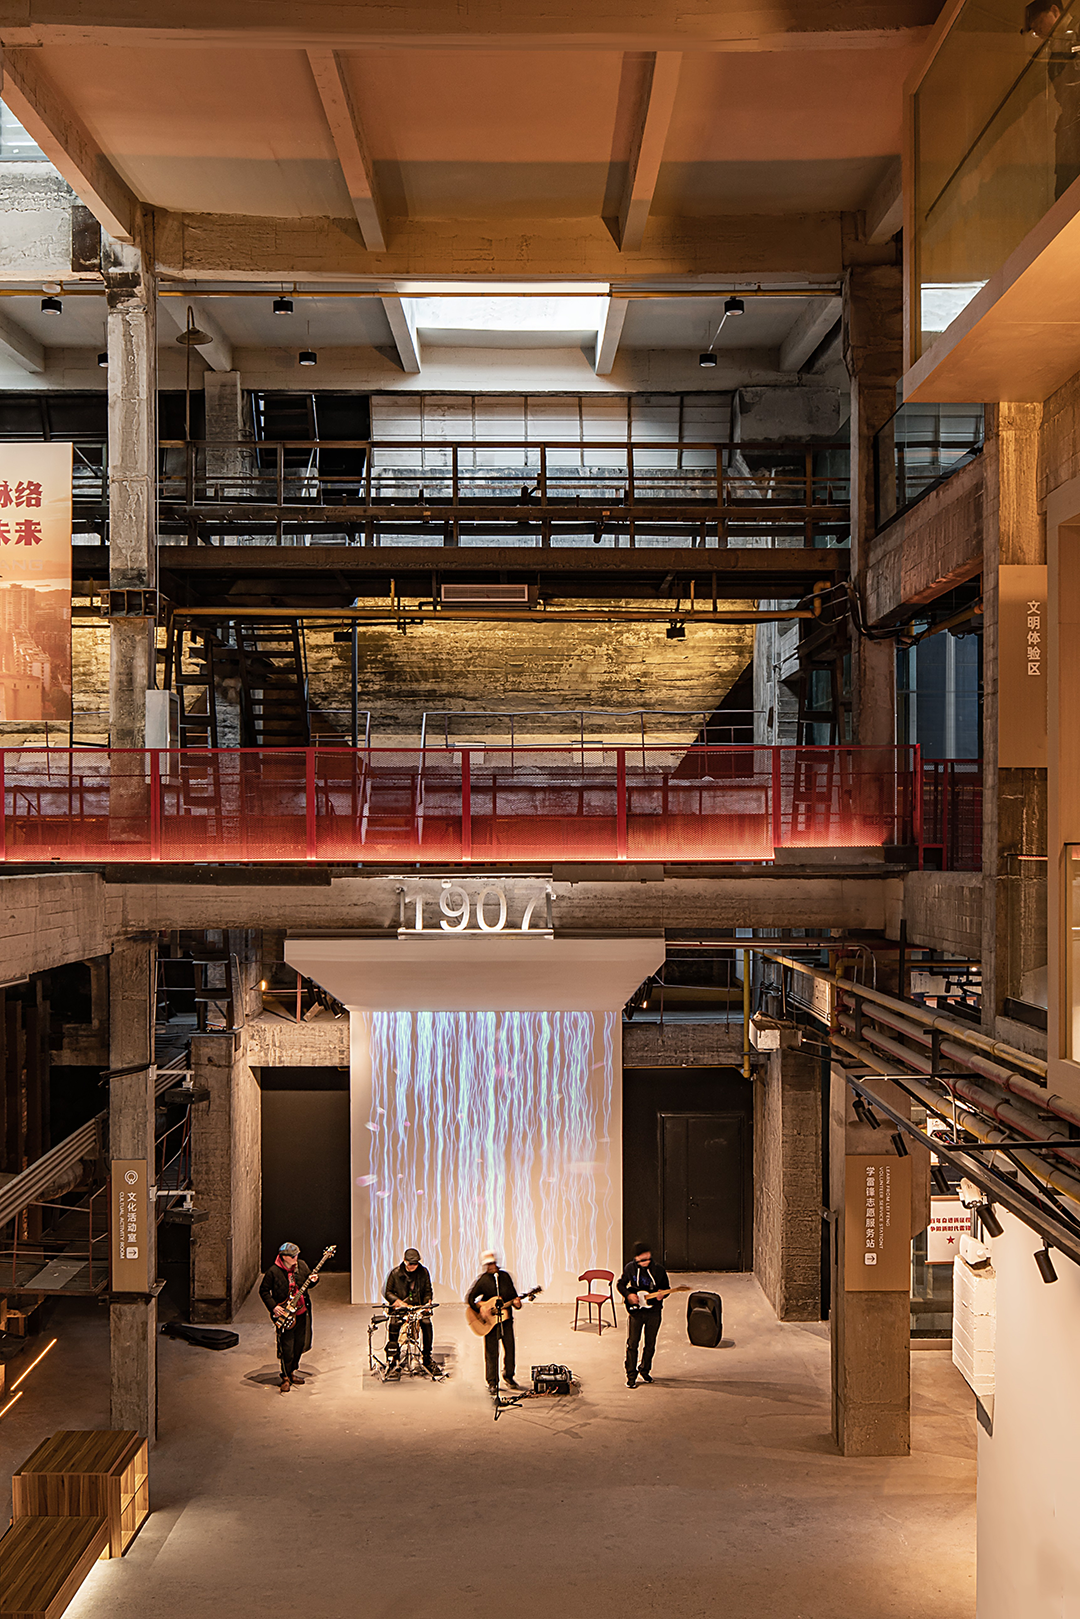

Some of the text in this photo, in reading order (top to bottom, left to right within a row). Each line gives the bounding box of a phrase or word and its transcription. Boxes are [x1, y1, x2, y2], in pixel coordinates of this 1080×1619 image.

[1026, 600, 1041, 676] 文明体验区
[405, 886, 546, 930] 1907
[127, 1191, 137, 1243] 文化活动室
[865, 1166, 876, 1248] 学雷锋志愿服务站
